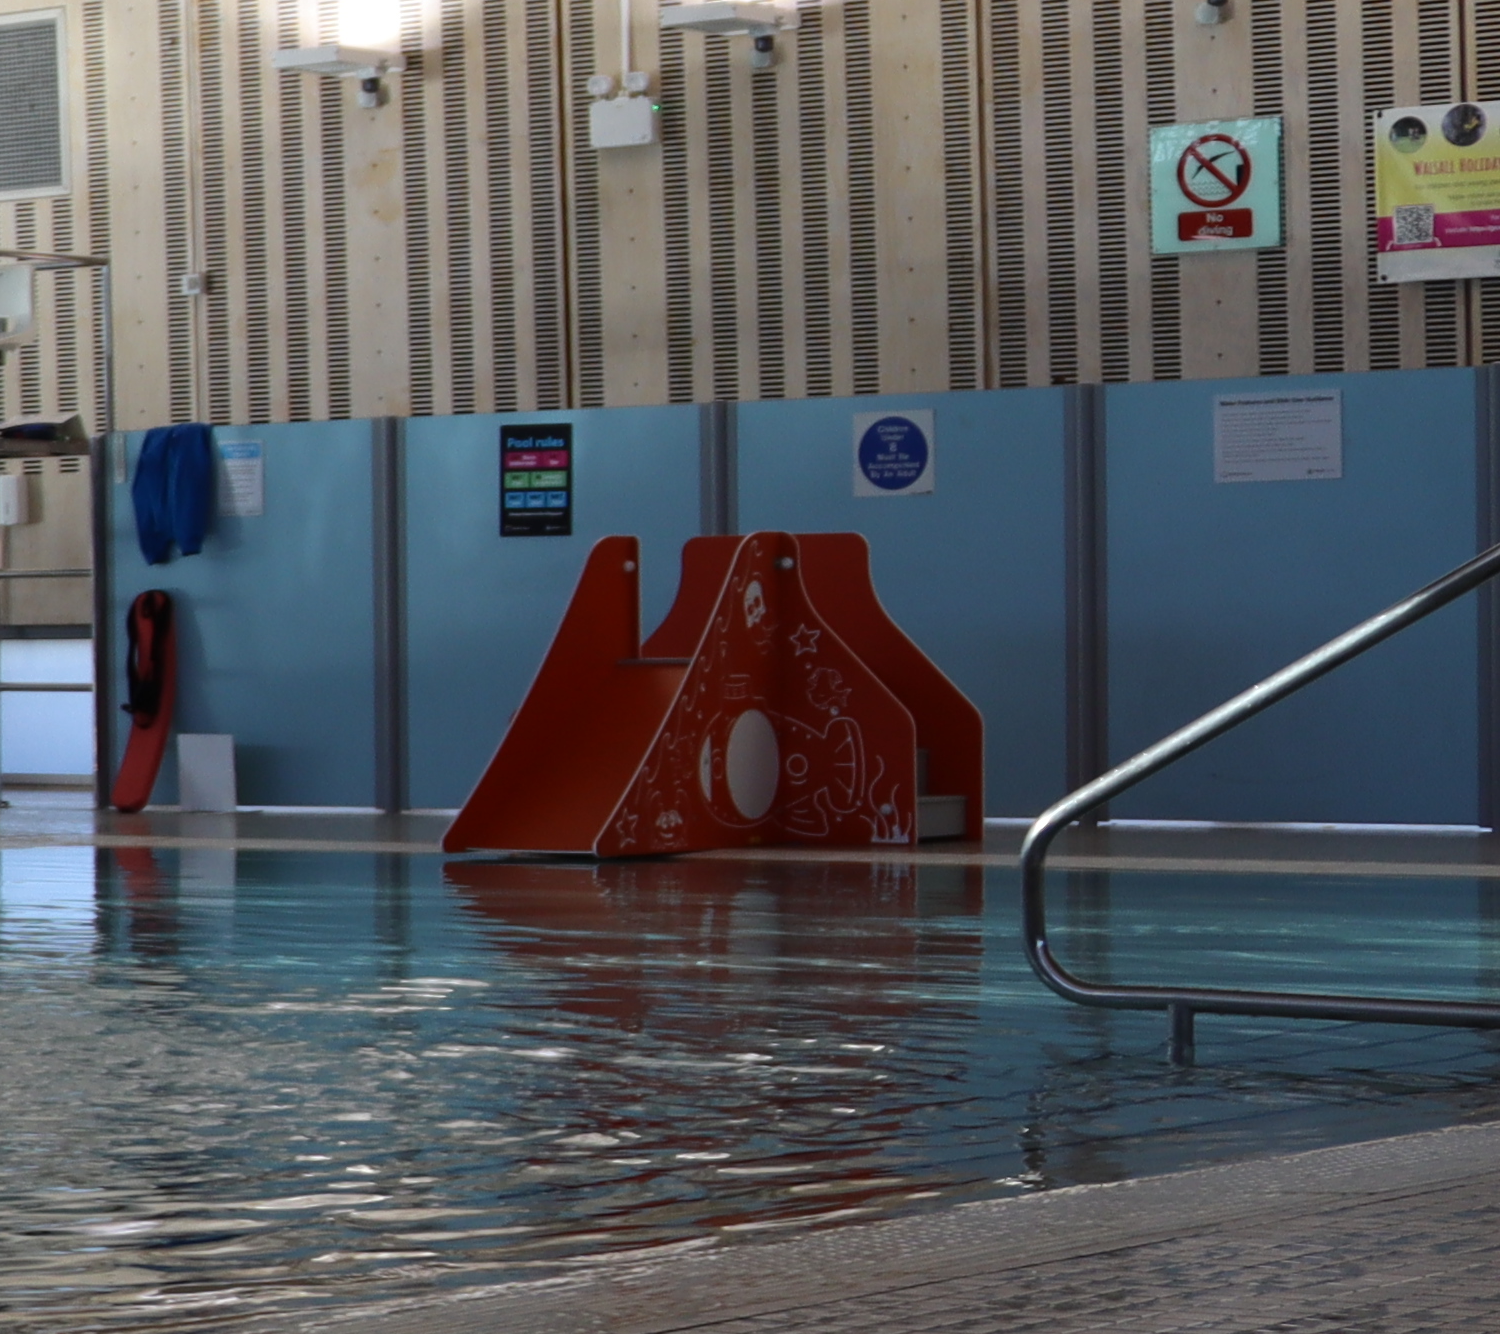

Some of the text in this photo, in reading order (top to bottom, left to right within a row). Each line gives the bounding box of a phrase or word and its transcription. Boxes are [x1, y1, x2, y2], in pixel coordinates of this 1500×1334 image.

[1206, 213, 1224, 223] No
[1198, 225, 1234, 237] diving
[507, 435, 566, 449] Pool rules
